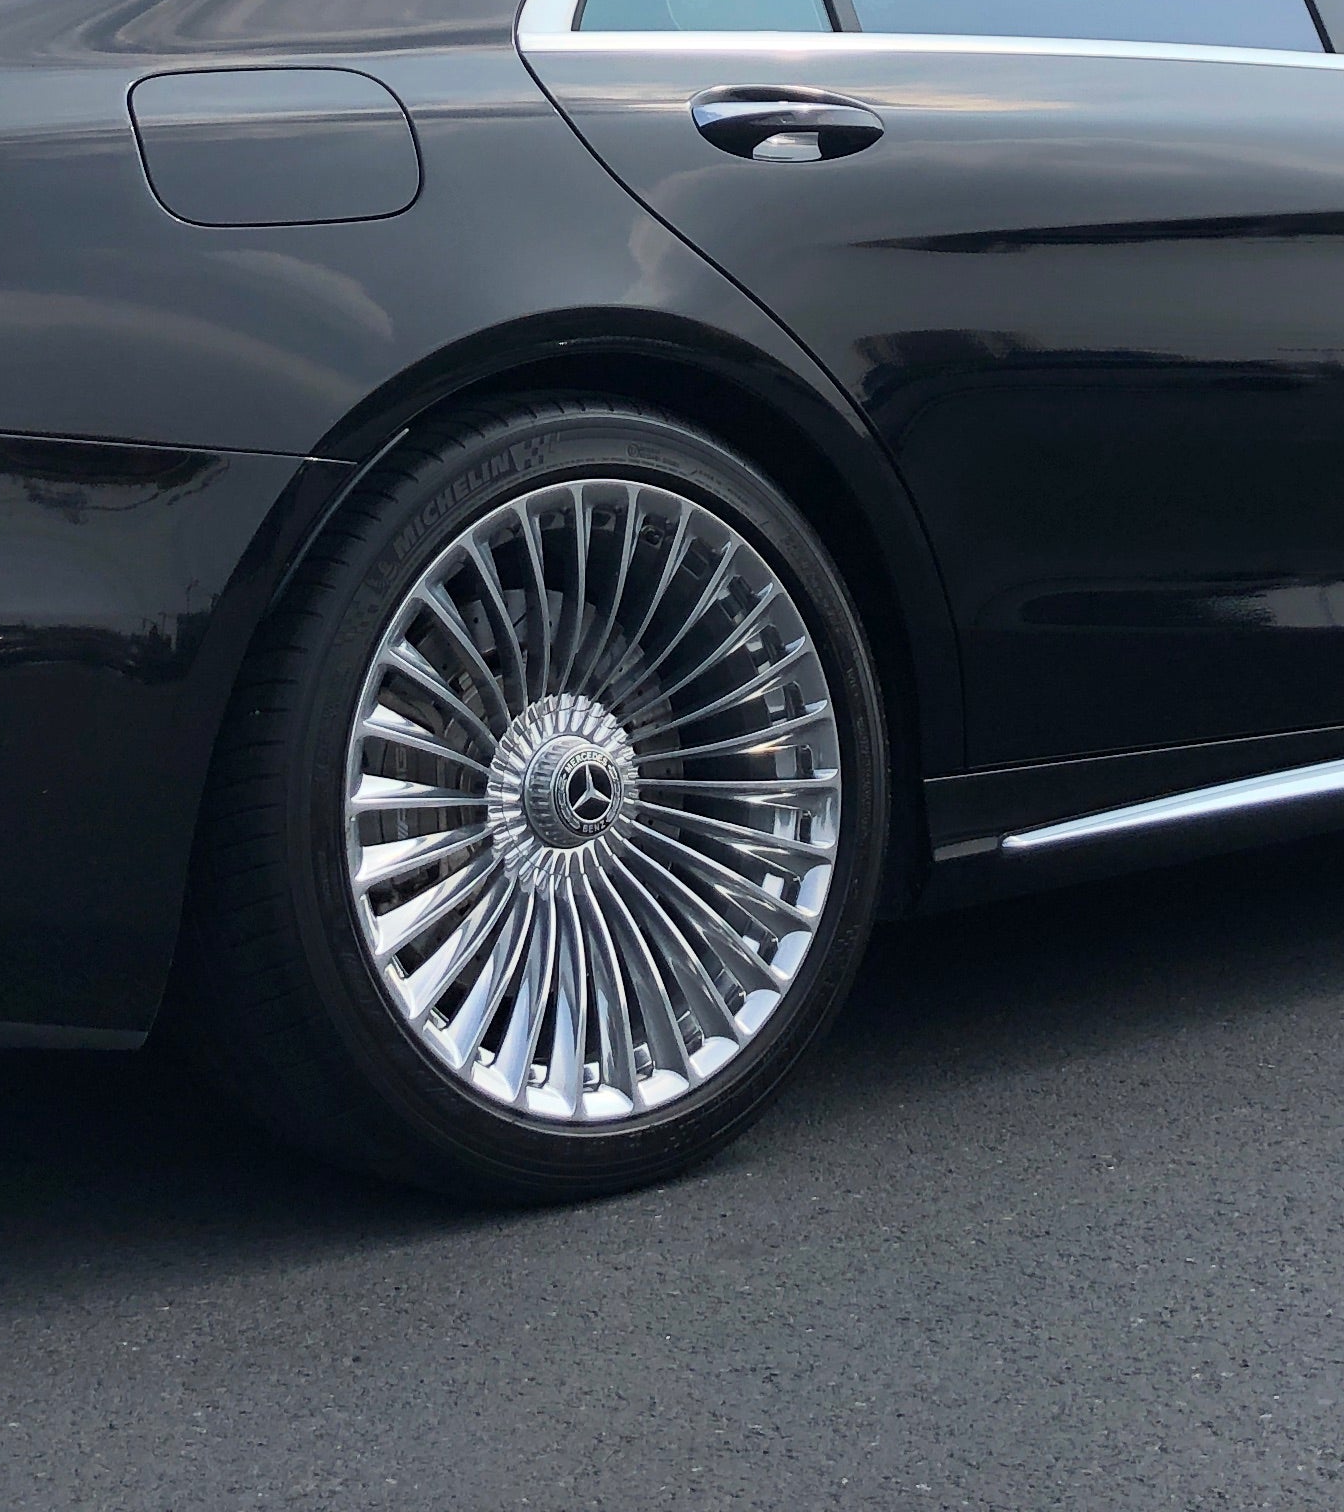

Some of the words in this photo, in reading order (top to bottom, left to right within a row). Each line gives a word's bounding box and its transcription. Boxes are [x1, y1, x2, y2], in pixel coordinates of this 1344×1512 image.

[391, 451, 513, 560] MICHELIN
[564, 751, 608, 774] MERCEDES
[582, 820, 606, 834] BENZ
